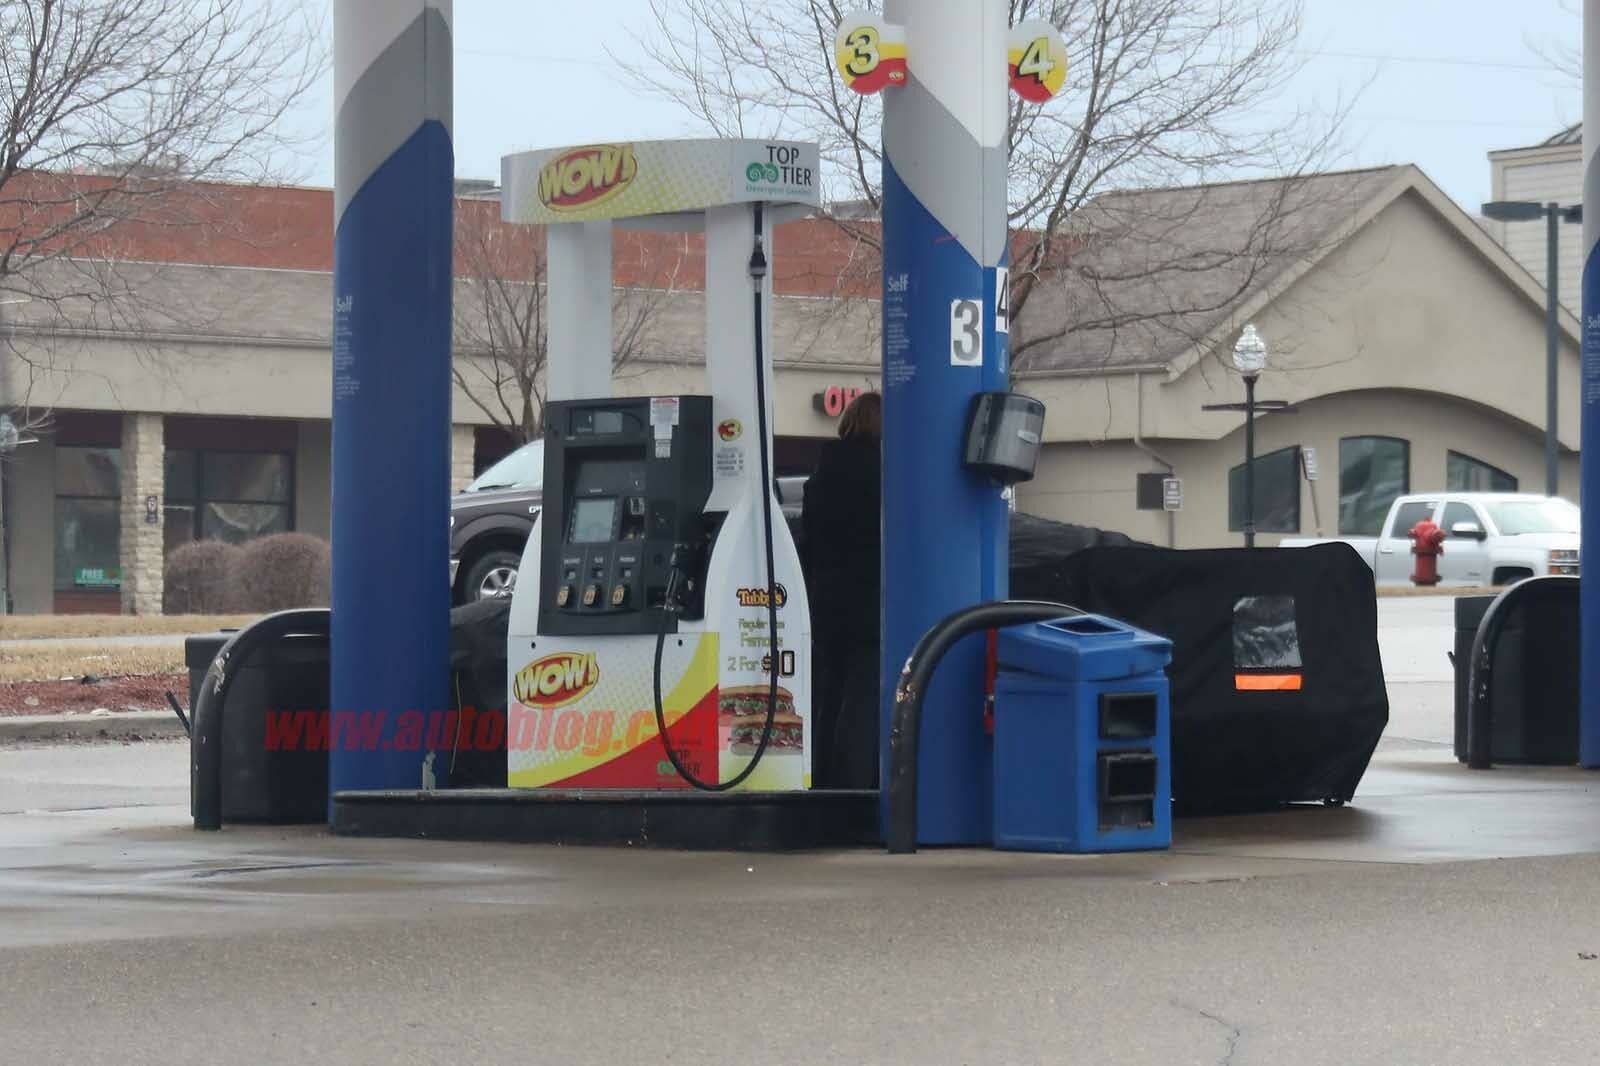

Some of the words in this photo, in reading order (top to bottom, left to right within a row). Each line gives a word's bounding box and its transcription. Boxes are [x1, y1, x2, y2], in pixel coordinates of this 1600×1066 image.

[844, 26, 881, 77] 3
[1017, 36, 1056, 85] 4
[541, 143, 635, 200] WOW!
[766, 145, 800, 165] TOP
[780, 166, 812, 187] TIER
[887, 275, 908, 292] Self
[996, 271, 1009, 330] 4
[952, 300, 981, 362] 3
[514, 652, 598, 702] WOW!
